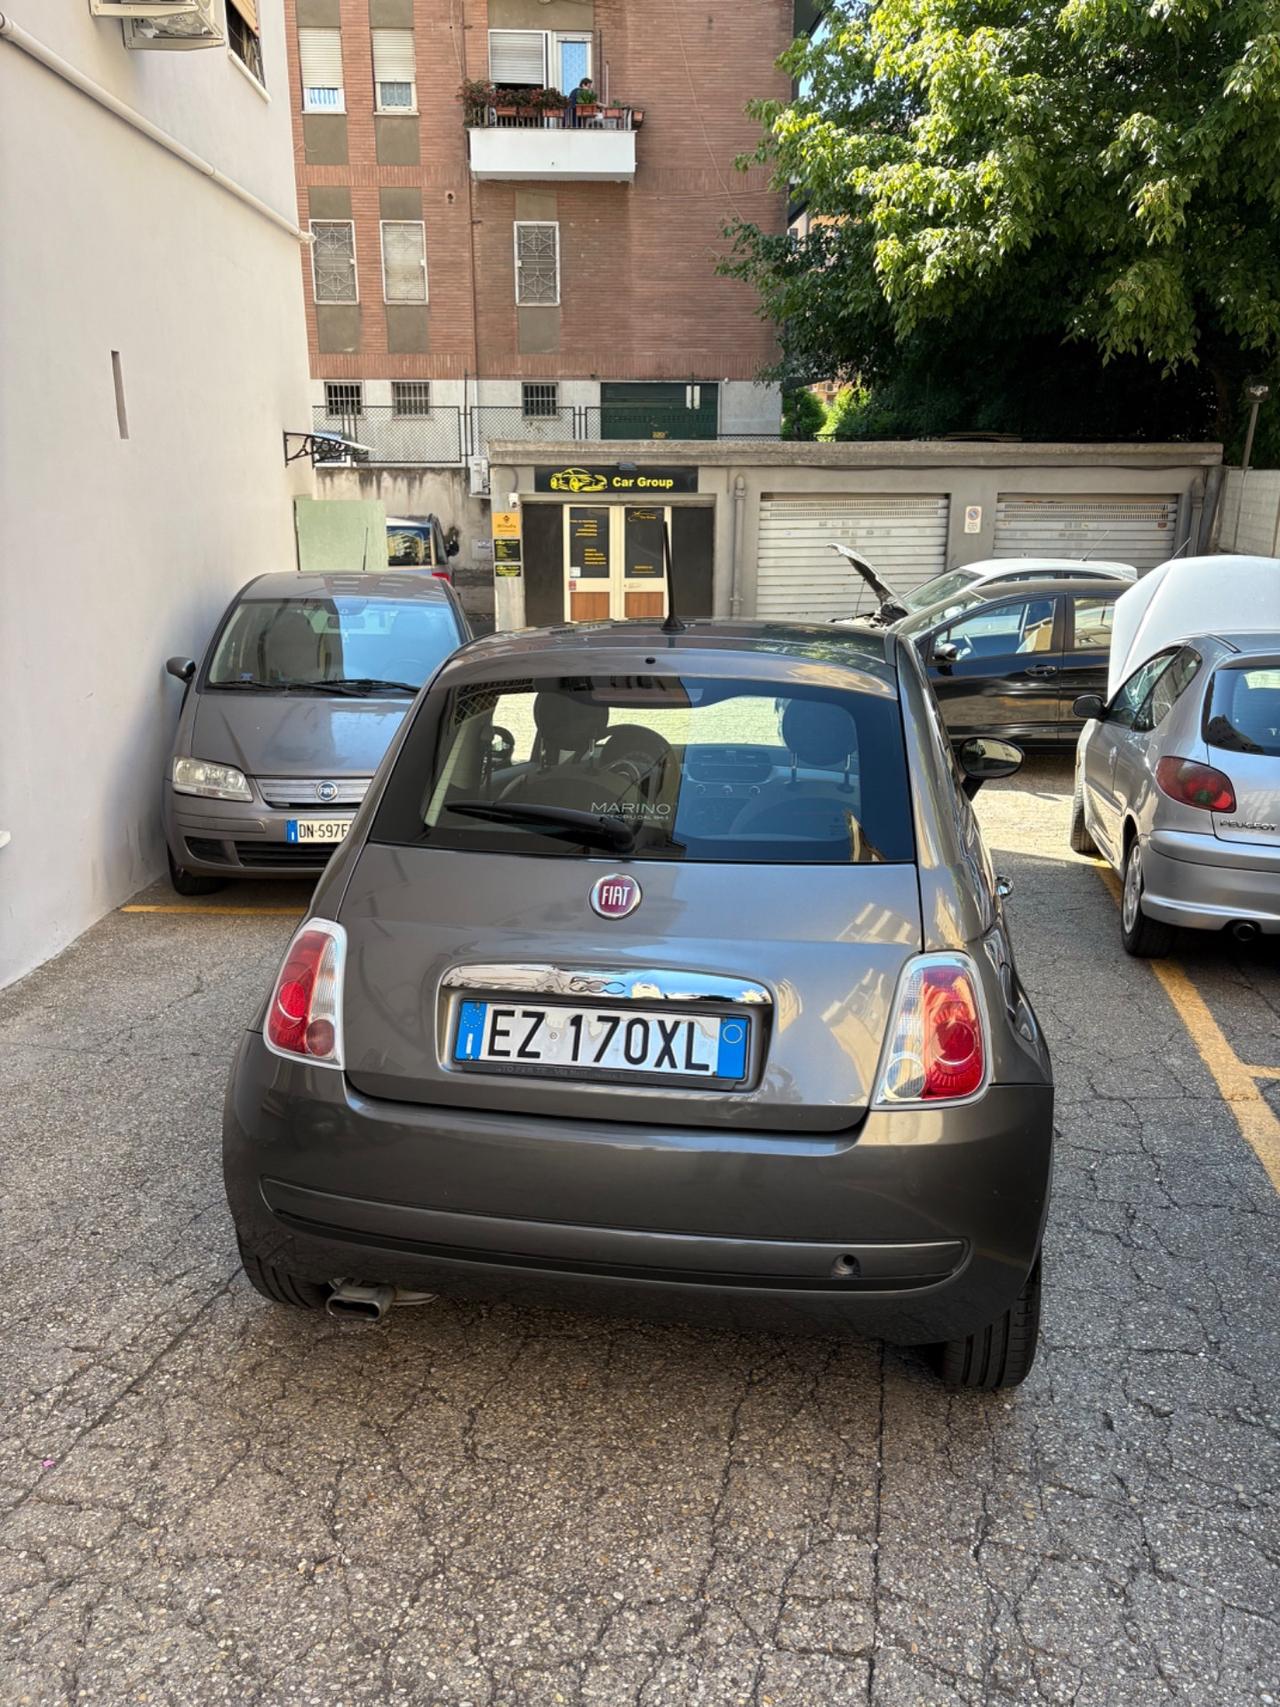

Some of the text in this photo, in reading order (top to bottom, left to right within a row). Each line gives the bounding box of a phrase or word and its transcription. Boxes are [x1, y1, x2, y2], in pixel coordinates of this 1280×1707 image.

[612, 476, 674, 489] Car Group
[590, 802, 671, 815] MARINO
[318, 824, 353, 838] 597F
[601, 885, 631, 906] FIAT
[487, 1008, 710, 1072] EZ 170XL
